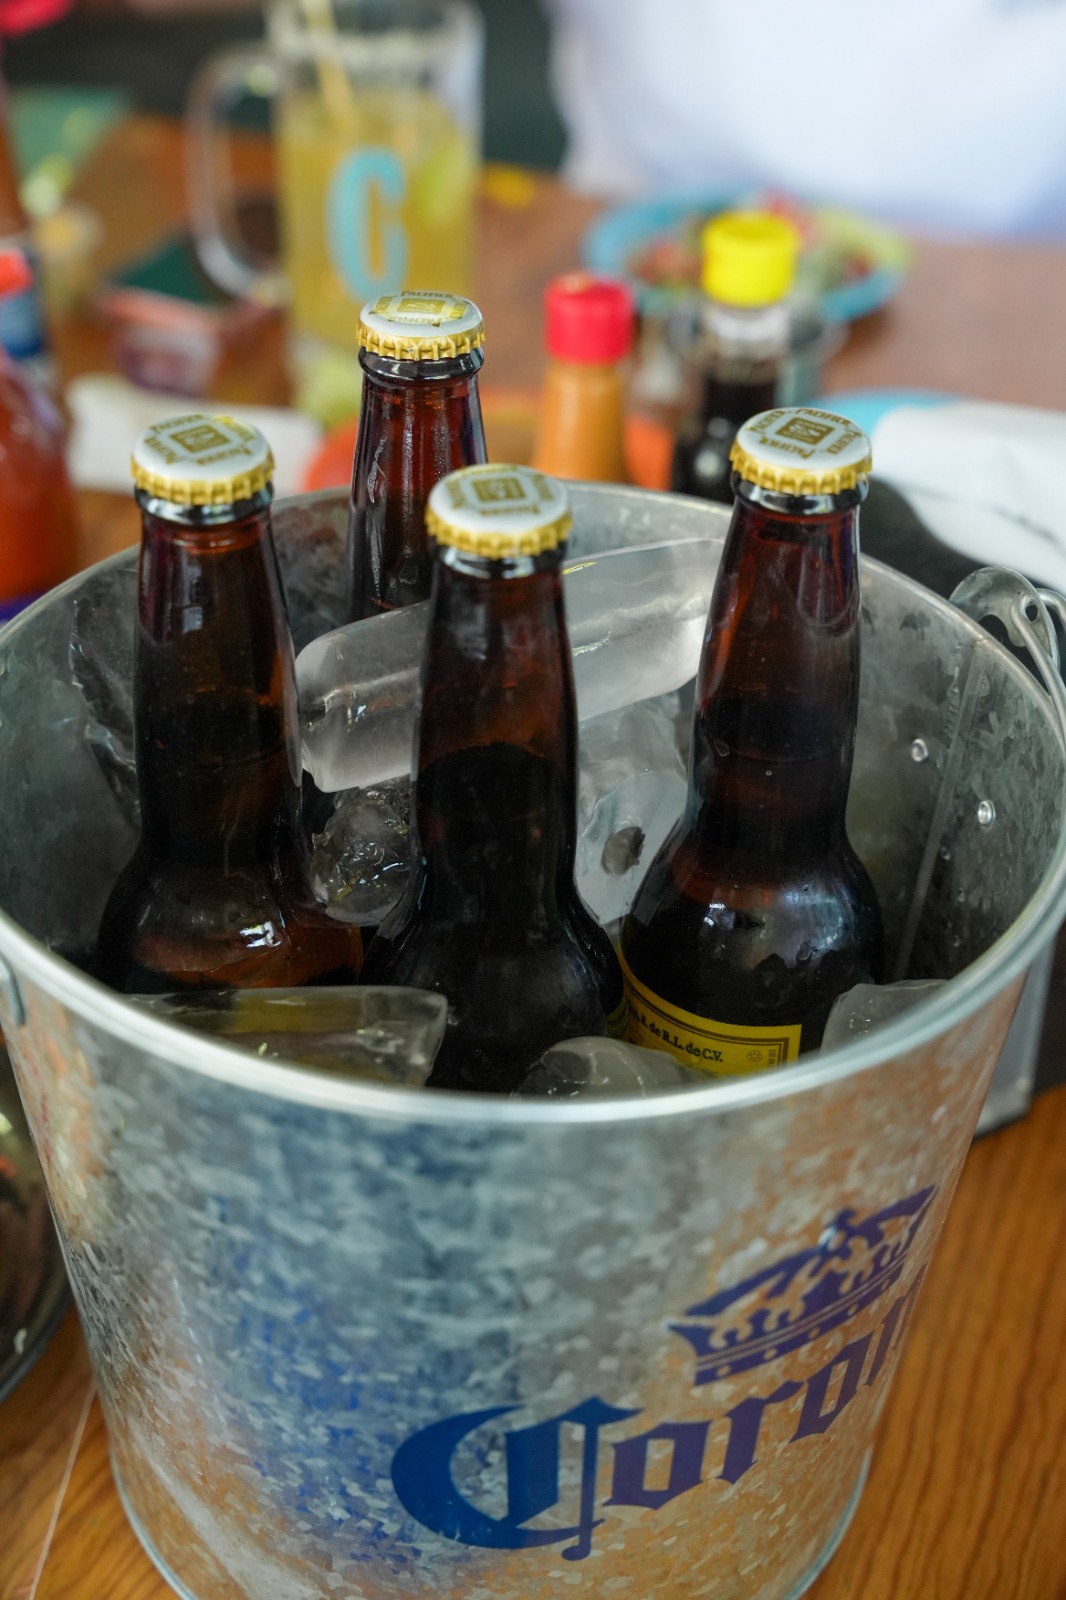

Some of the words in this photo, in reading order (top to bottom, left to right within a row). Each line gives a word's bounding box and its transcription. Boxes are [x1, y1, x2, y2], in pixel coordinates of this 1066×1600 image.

[649, 1021, 662, 1038] de
[685, 1041, 702, 1057] de
[702, 1048, 724, 1063] C.V.
